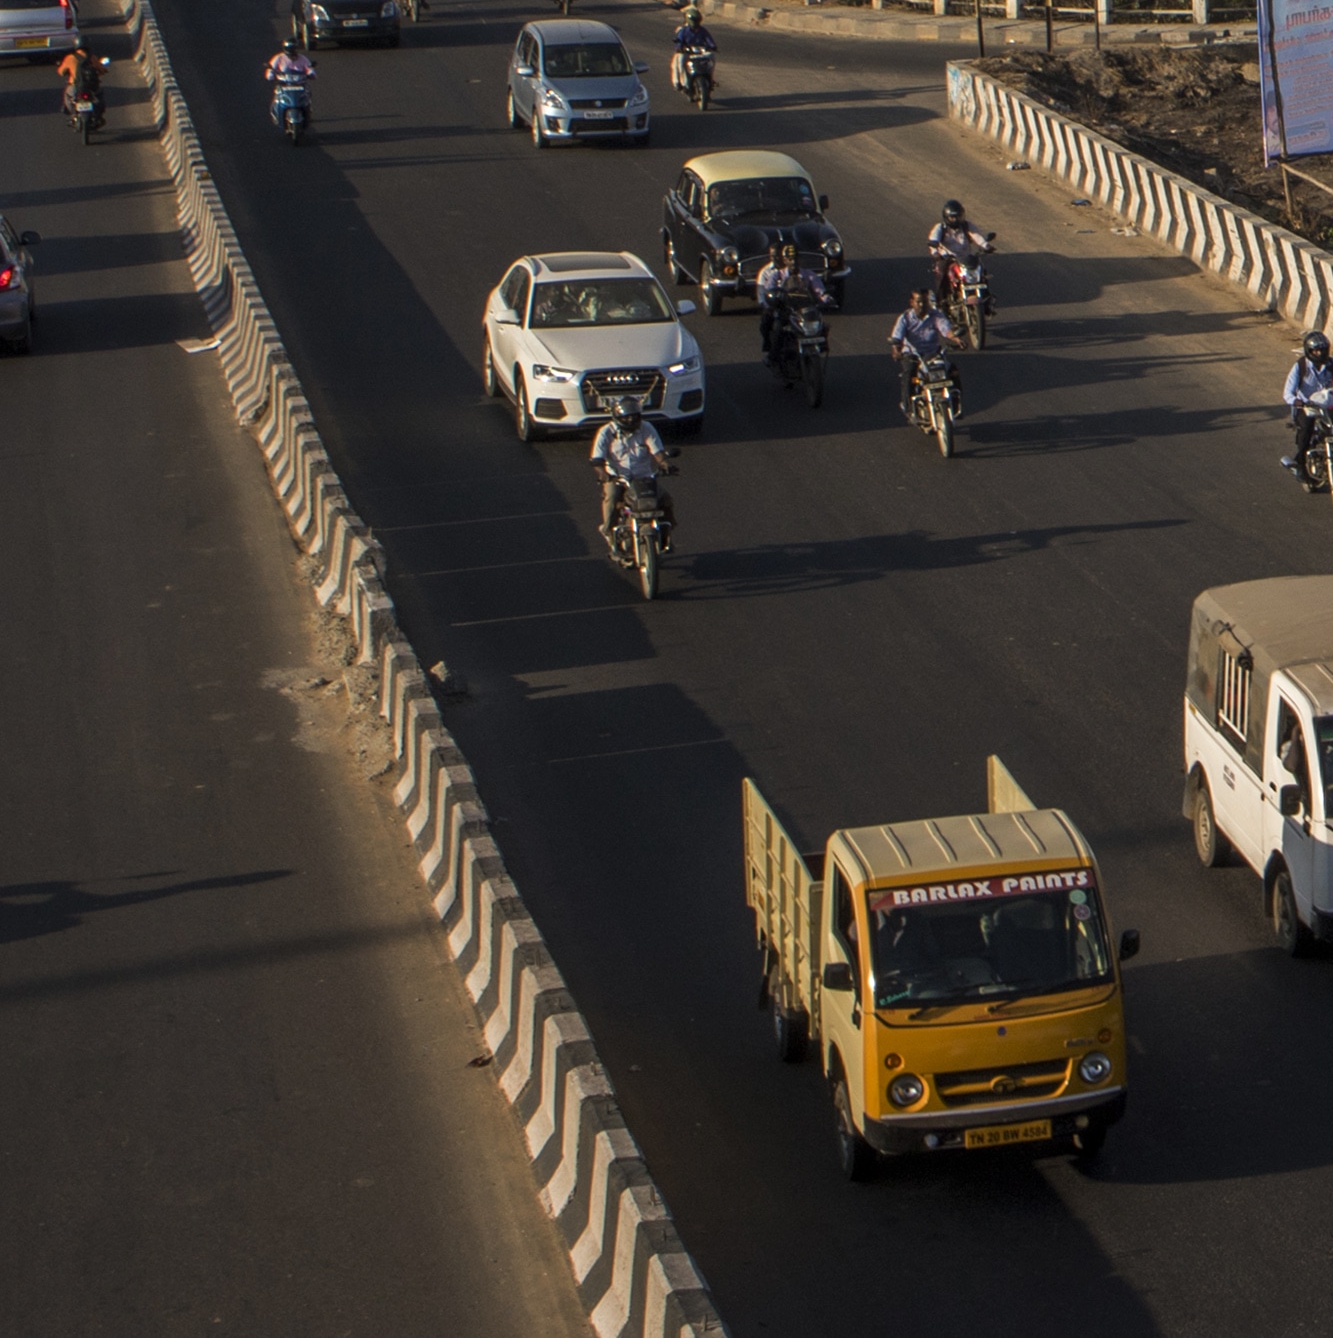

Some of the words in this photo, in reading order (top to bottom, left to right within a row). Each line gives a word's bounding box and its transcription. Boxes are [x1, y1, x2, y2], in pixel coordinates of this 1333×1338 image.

[893, 881, 993, 905] BARLAX
[1002, 871, 1088, 892] PAINTS
[970, 1133, 984, 1144] TN
[987, 1131, 1000, 1142] 20
[1003, 1128, 1020, 1141] BW
